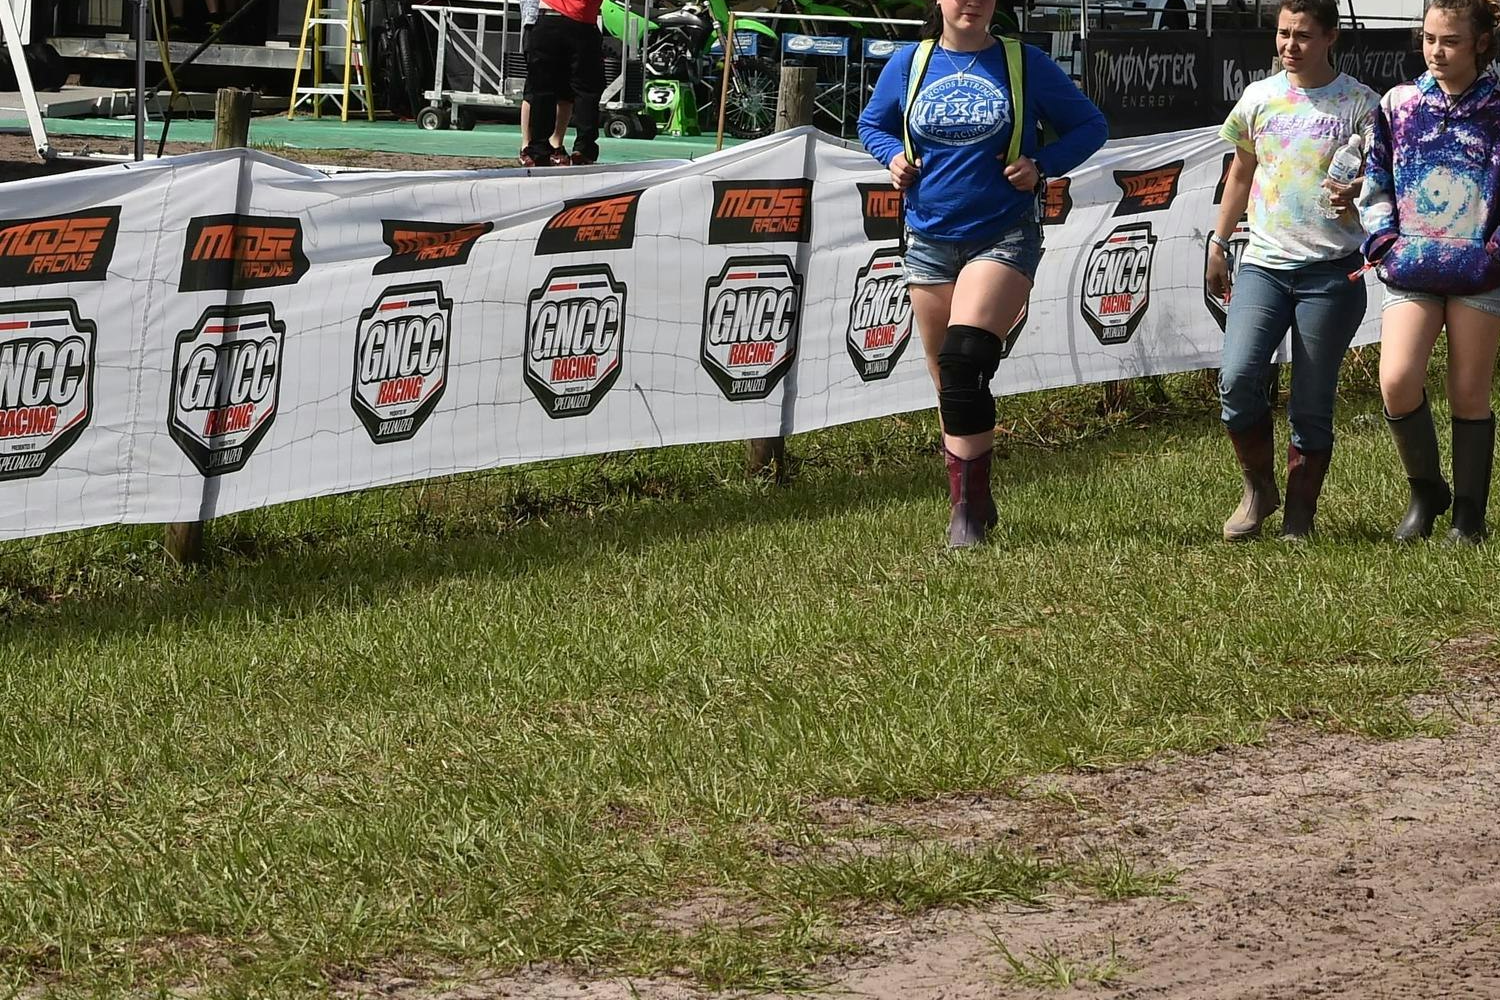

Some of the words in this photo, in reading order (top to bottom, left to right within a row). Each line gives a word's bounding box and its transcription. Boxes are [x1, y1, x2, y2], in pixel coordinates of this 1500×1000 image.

[651, 90, 671, 105] 3
[925, 81, 956, 99] WOODS
[957, 80, 994, 99] EXTREME
[1122, 95, 1175, 108] ENERGY
[547, 195, 638, 229] MOOSE
[715, 187, 808, 218] MOOSE
[0, 217, 112, 256] MOOSE
[574, 224, 621, 242] RACING
[751, 216, 800, 234] RACING
[26, 253, 94, 274] RACING
[1086, 246, 1150, 297] GNCC
[709, 288, 798, 345] GNCC
[854, 279, 912, 331] GNCC
[1099, 294, 1133, 315] RACING
[531, 296, 619, 360] GNCC
[863, 325, 896, 349] RACING
[360, 313, 445, 385] GNCC
[728, 342, 776, 367] RACING
[0, 339, 85, 408] NCC
[180, 336, 278, 412] GNCC
[551, 355, 598, 382] RACING
[375, 377, 424, 407] RACING
[204, 403, 254, 437] RACING
